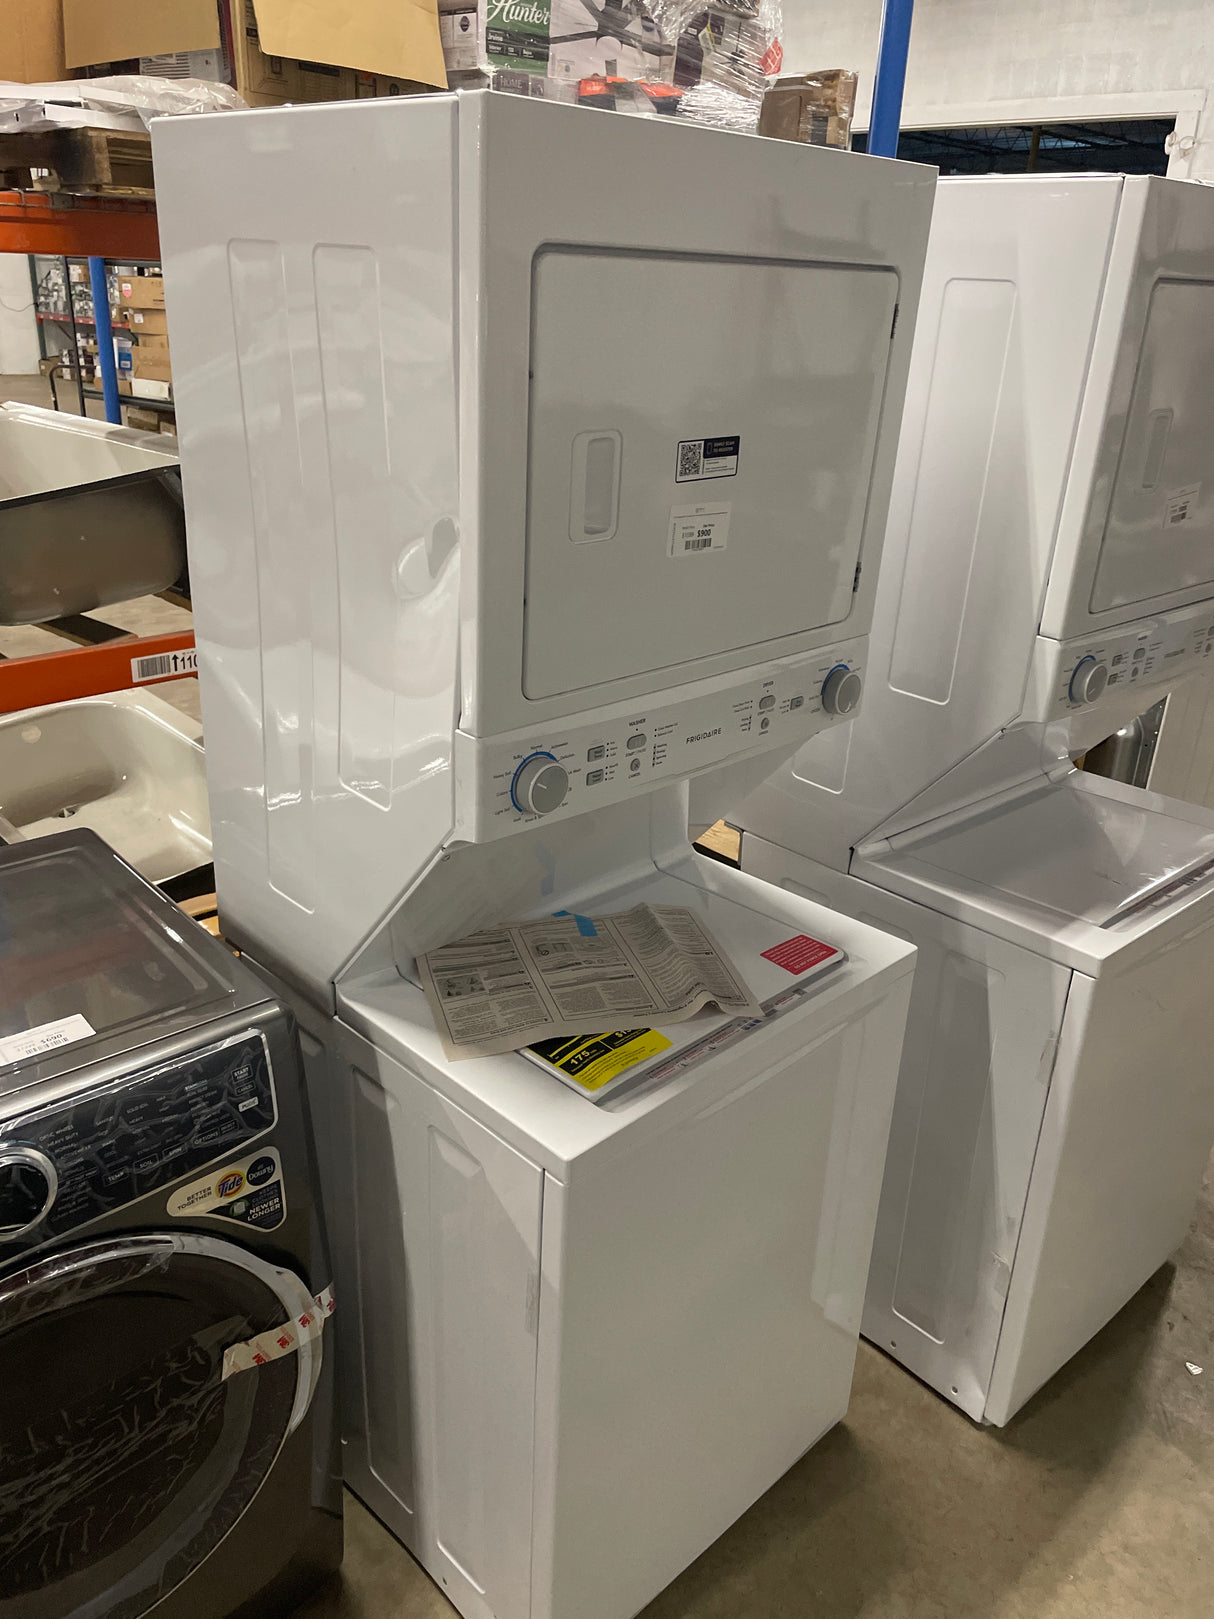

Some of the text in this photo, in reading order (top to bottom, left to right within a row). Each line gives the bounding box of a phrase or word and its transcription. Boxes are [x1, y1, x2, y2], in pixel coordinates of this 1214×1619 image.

[487, 0, 550, 25] Hunter
[697, 529, 712, 538] $900
[628, 718, 646, 727] WASHER
[686, 727, 722, 744] FRIGIDAIRE
[40, 1033, 63, 1044] $690
[570, 1050, 590, 1066] 175
[233, 1067, 249, 1077] START
[194, 1130, 219, 1145] OPTIONS
[107, 1171, 125, 1182] TEMP
[248, 1164, 274, 1180] Downy
[186, 1186, 212, 1201] BETTER
[218, 1176, 244, 1198] Tide
[177, 1191, 212, 1210] TOGETHER
[249, 1197, 280, 1214] NEWER
[247, 1203, 281, 1221] LONGER
[298, 1314, 311, 1328] 3M
[276, 1335, 290, 1349] 3M
